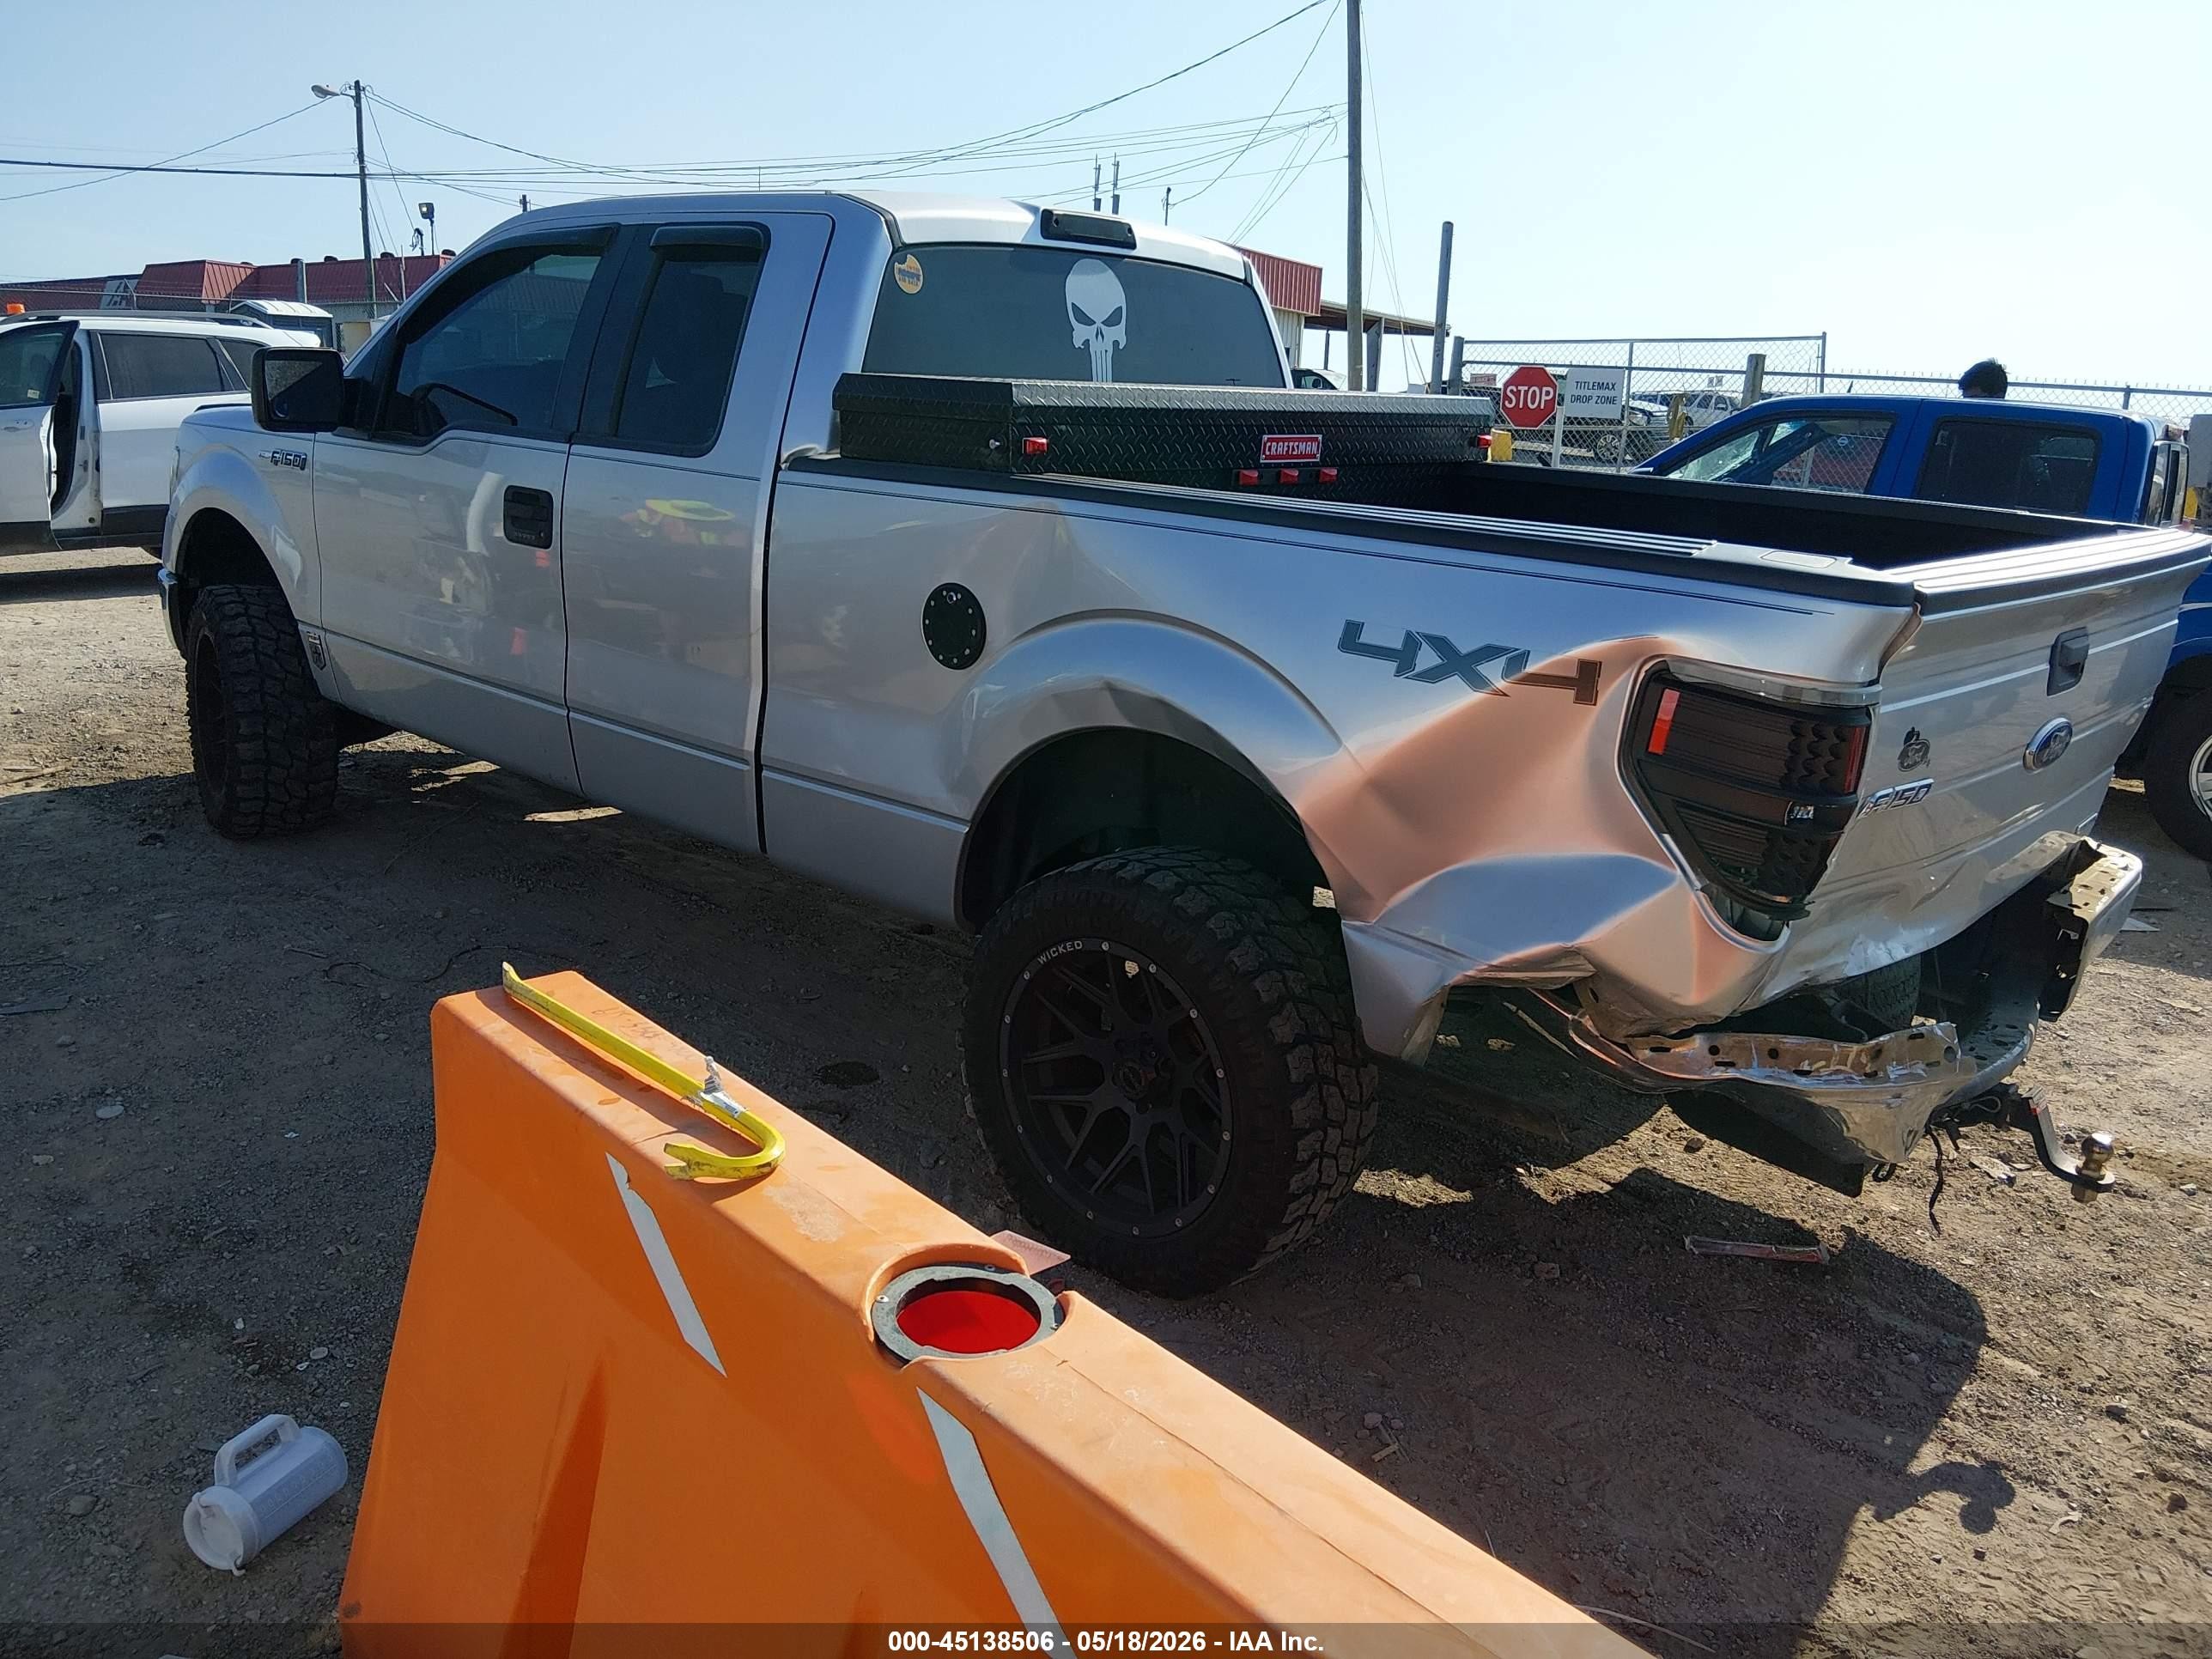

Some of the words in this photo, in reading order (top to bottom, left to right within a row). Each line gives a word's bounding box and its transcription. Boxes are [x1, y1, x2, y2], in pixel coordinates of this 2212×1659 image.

[1575, 380, 1616, 392] TITLEMAX
[1504, 385, 1554, 410] STOP
[1571, 394, 1593, 404] DROP
[1595, 395, 1618, 405] ZONE
[1265, 441, 1318, 456] CRAFTSMAN
[1036, 940, 1083, 964] WICKED
